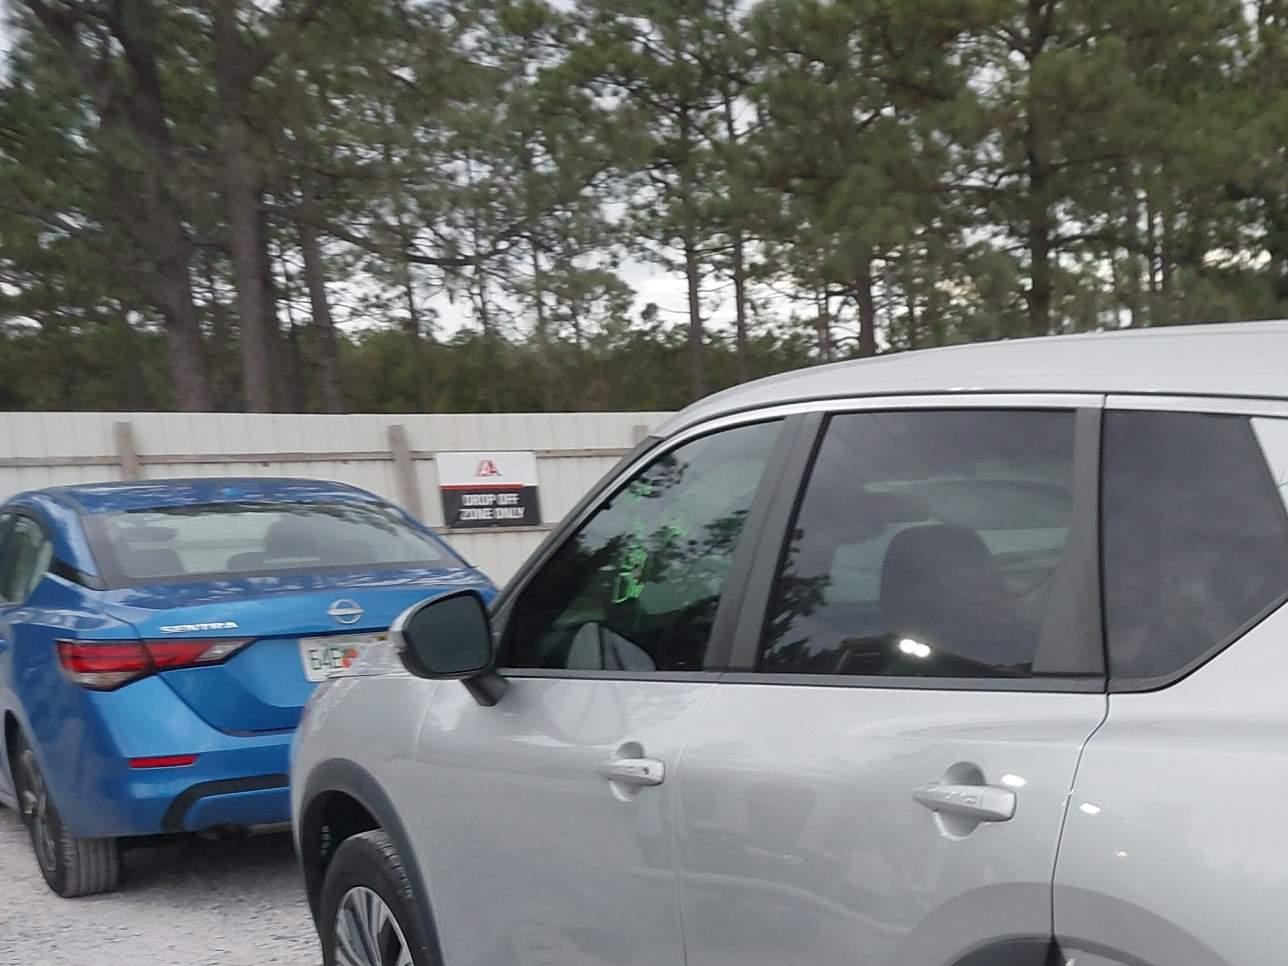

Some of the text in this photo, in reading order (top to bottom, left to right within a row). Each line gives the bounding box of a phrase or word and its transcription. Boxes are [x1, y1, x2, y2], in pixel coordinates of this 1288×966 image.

[462, 493, 520, 506] DROP OFF
[459, 507, 525, 520] ZONE ONLY
[159, 621, 240, 634] SENTRA
